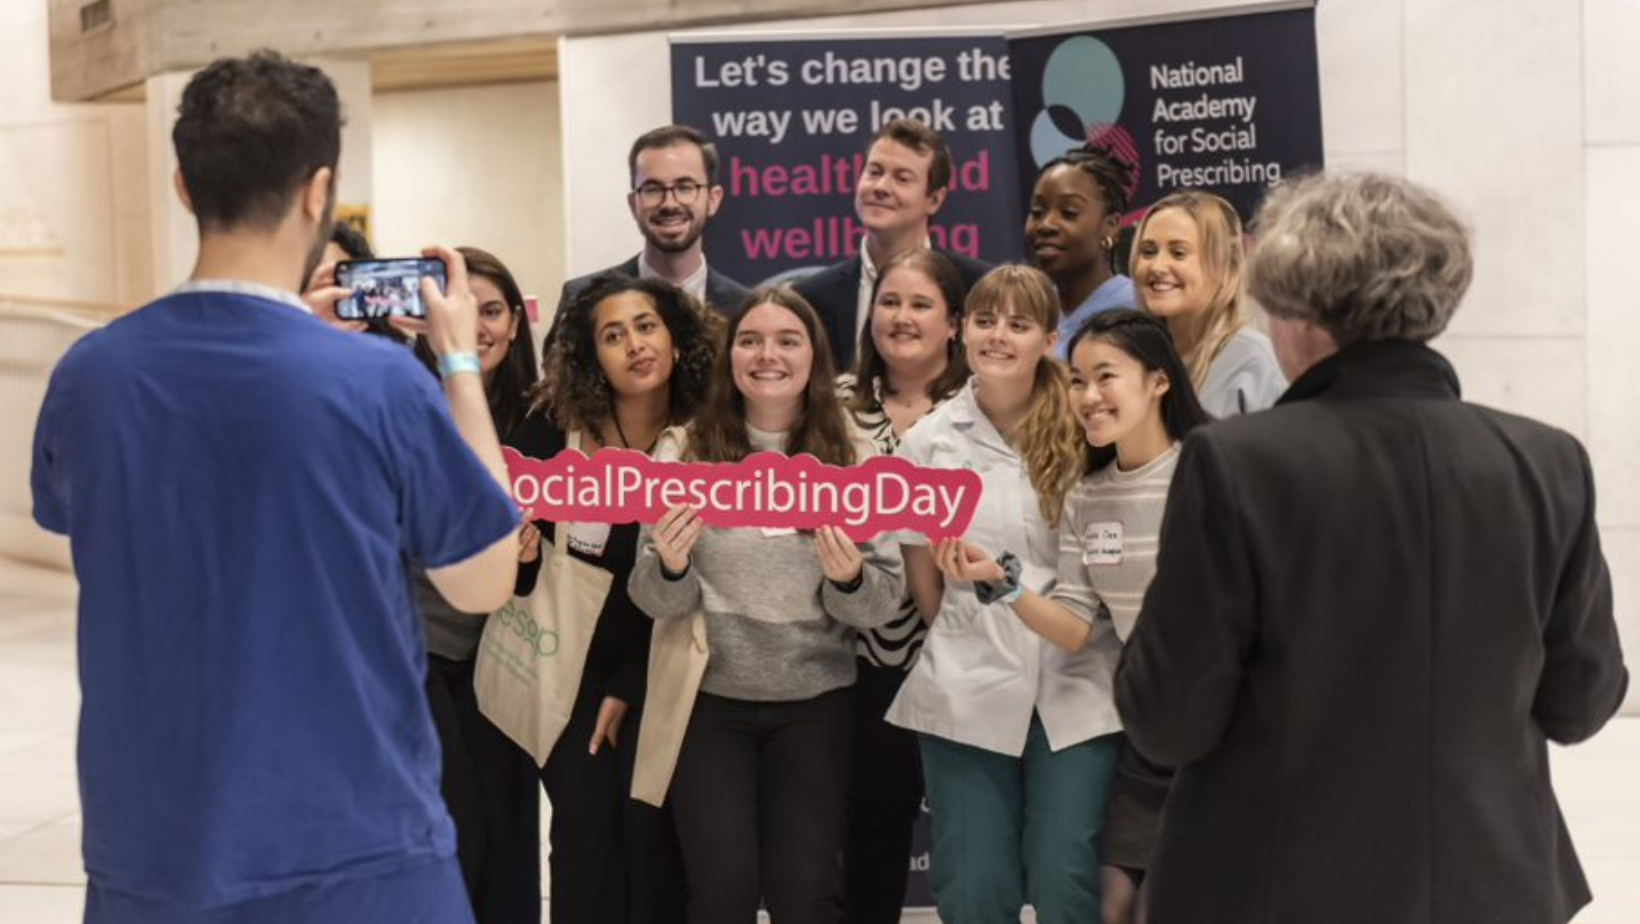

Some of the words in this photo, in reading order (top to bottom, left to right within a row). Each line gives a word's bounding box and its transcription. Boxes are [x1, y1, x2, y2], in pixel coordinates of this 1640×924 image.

[695, 54, 790, 87] Let's
[801, 51, 946, 90] change
[957, 47, 1012, 81] the
[1150, 56, 1244, 89] National
[712, 109, 792, 144] way
[802, 108, 858, 135] we
[967, 100, 1005, 131] at
[1152, 93, 1256, 123] Academy
[1154, 128, 1188, 155] for
[1191, 122, 1256, 152] Social
[1157, 157, 1281, 188] Prescribing
[741, 216, 980, 259] wellbng
[513, 464, 966, 528] ocialPrescribingDay
